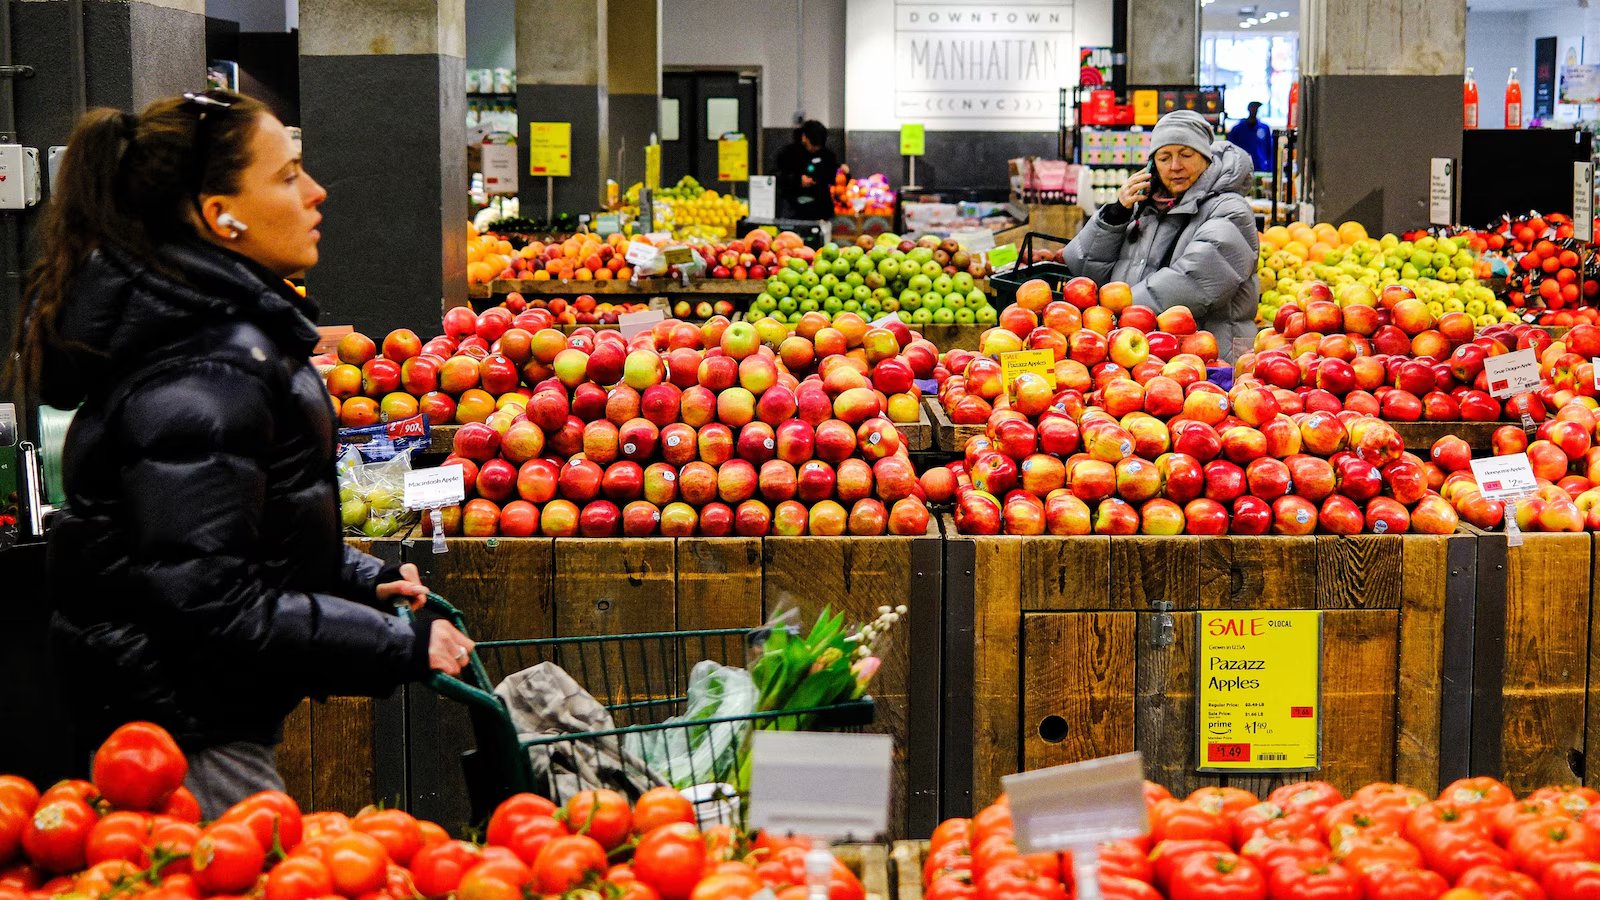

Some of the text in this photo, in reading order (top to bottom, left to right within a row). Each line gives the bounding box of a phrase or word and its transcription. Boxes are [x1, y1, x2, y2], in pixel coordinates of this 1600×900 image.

[909, 12, 1060, 23] DOWNTOWN
[911, 39, 1057, 81] MANHATTAN
[962, 100, 1005, 110] NYC
[408, 476, 459, 488] Macintosh Apple
[1207, 617, 1292, 637] SALE LOCAL
[1209, 656, 1266, 671] Pazazz
[1208, 675, 1260, 692] Apples
[1208, 720, 1232, 729] prime
[1216, 745, 1242, 758] $1.49
